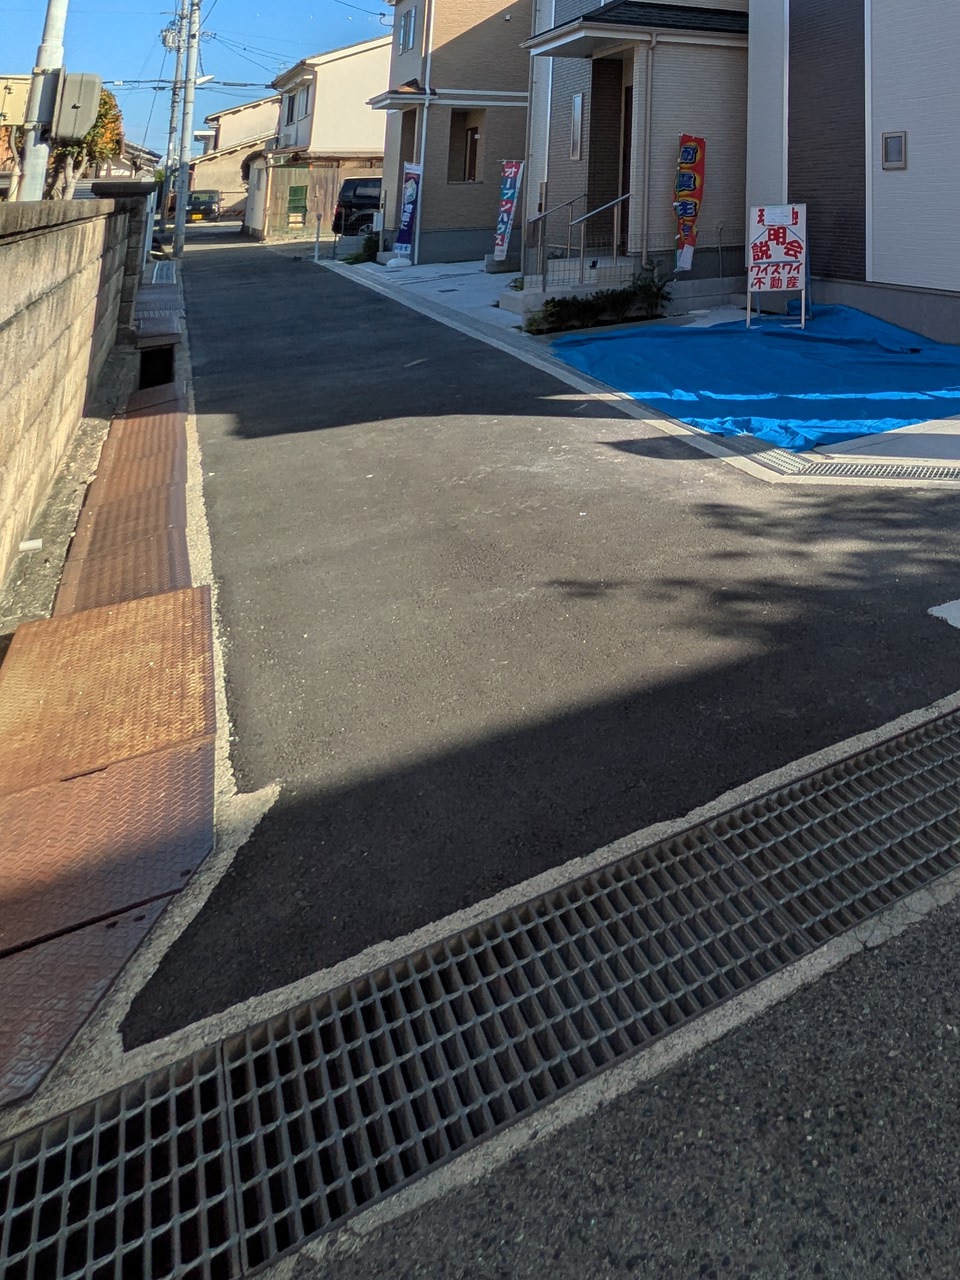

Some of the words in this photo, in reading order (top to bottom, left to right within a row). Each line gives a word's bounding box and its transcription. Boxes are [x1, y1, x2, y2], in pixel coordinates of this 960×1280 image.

[751, 225, 804, 262] 説明会
[750, 263, 803, 276] ワイズワイ
[752, 276, 800, 289] 不動産
